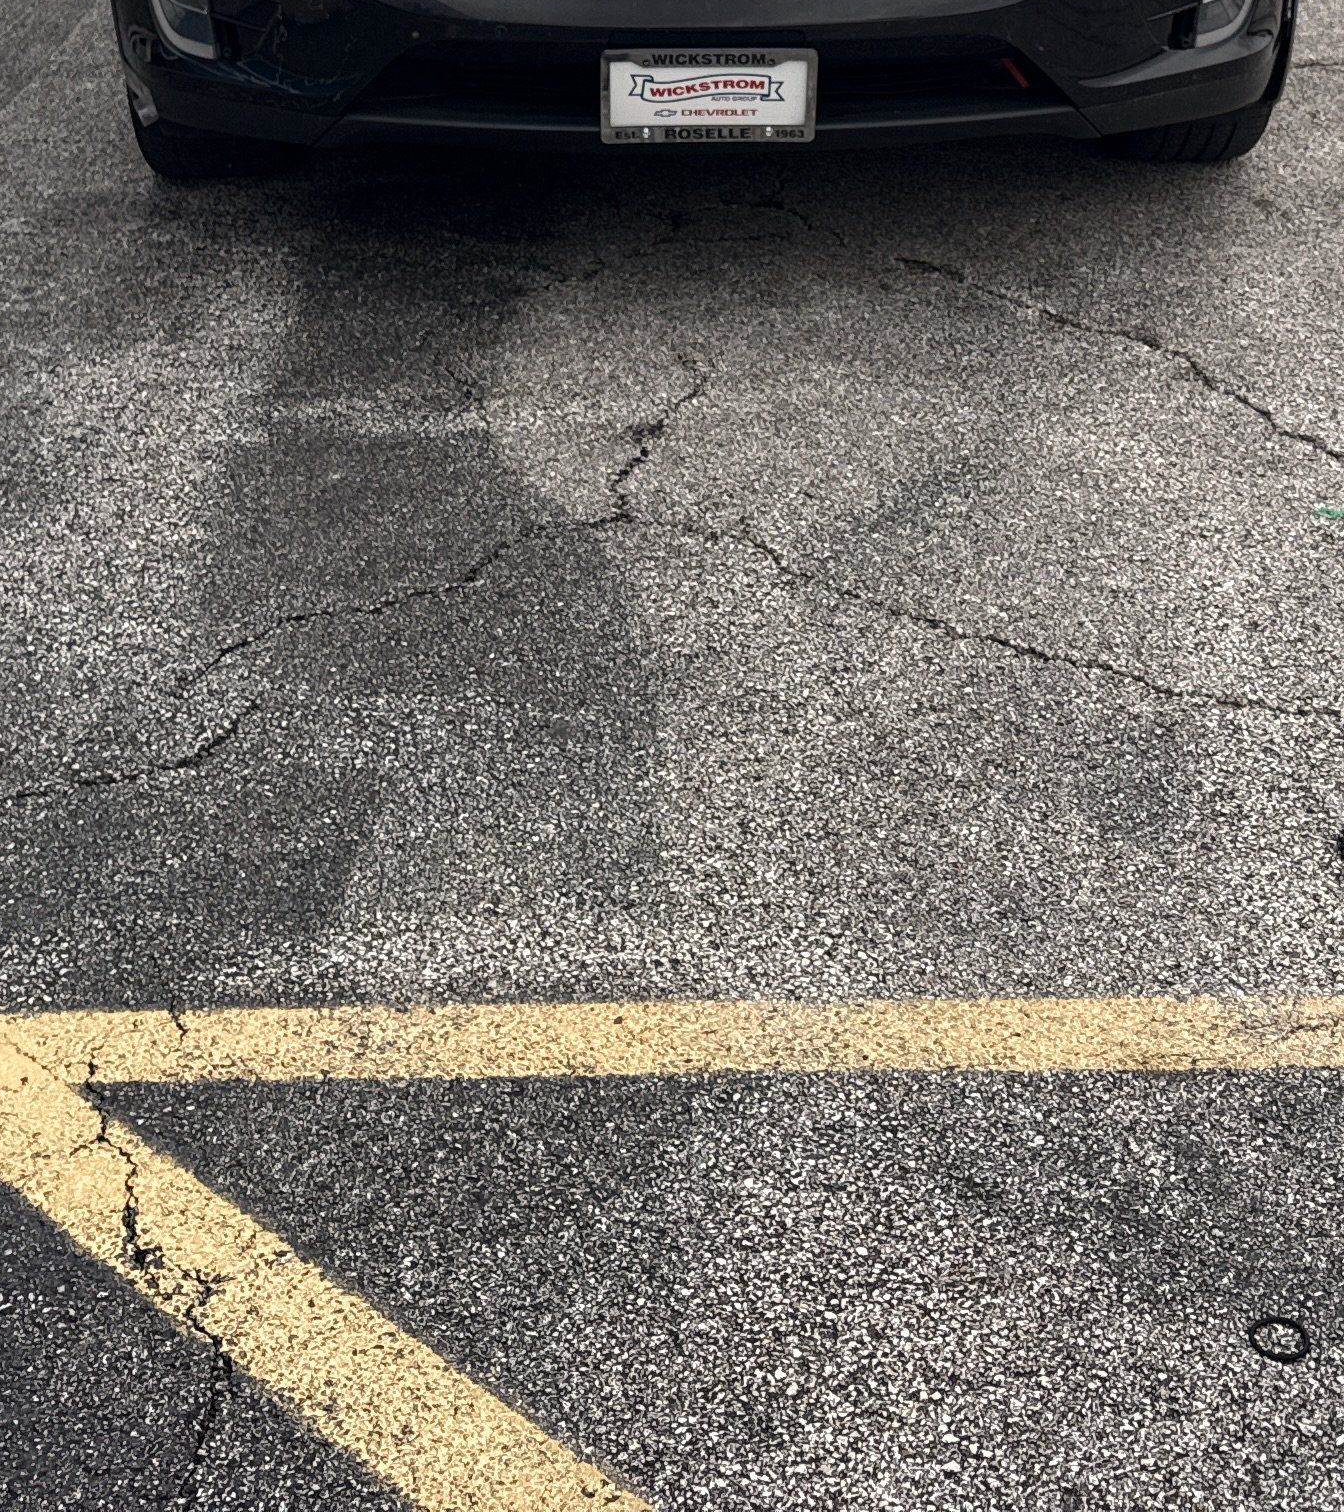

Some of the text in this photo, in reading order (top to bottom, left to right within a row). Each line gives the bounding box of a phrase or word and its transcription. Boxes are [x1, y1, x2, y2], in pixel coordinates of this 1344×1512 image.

[651, 53, 767, 66] WICKSTROM
[649, 79, 766, 98] WICKSTROM
[681, 109, 759, 117] CHEVROLET
[664, 127, 752, 140] ROSELLE
[775, 129, 805, 139] 1963
